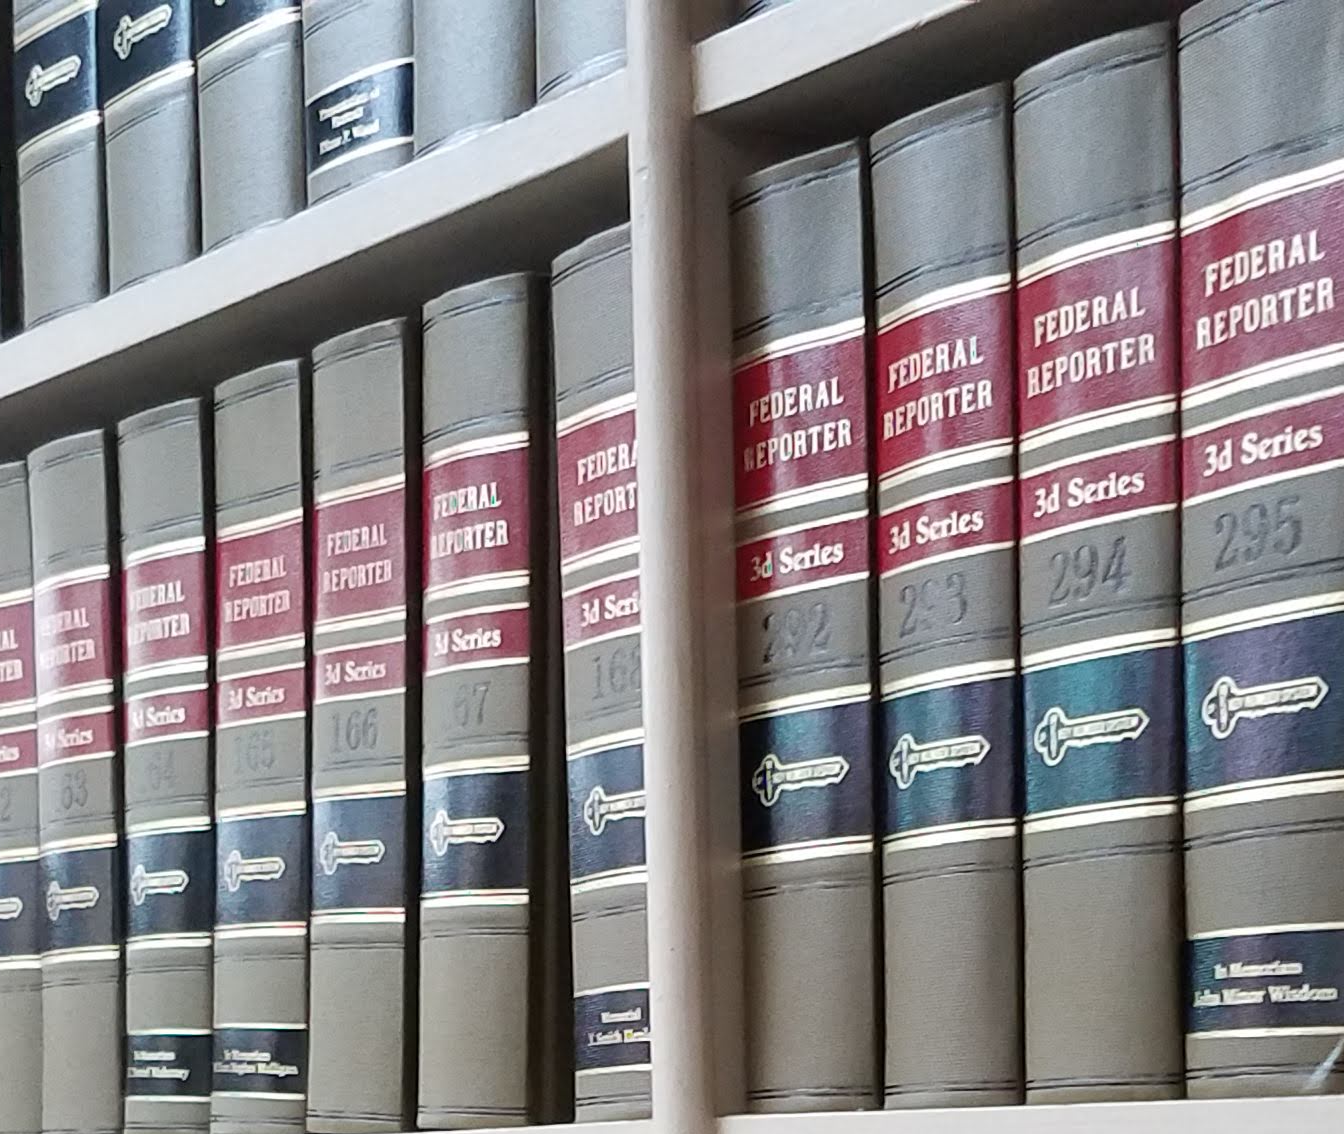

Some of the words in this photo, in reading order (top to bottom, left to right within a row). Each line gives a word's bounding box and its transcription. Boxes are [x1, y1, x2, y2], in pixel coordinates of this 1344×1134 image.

[1203, 228, 1326, 297] FEDERAL
[1033, 286, 1145, 348] FEDERAL
[1196, 277, 1335, 350] REPORTER
[887, 336, 984, 393] FEDERAL
[1026, 333, 1156, 399] REPORTER
[750, 375, 844, 427] FEDERAL
[882, 380, 994, 441] REPORTER
[577, 440, 637, 485] FEDERA
[744, 417, 852, 472] REPORTER
[1203, 440, 1234, 477] 3d
[1240, 423, 1323, 464] Series
[432, 481, 502, 521] FEDERAL
[573, 483, 637, 526] REPORT
[1033, 482, 1059, 518] 3d
[1067, 470, 1145, 508] Series
[326, 523, 387, 557] FEDERAL
[888, 524, 911, 556] 3d
[916, 507, 984, 545] Series
[1213, 497, 1301, 572] 295
[228, 556, 286, 587] FEDERAL
[322, 559, 392, 594] REPORTER
[750, 547, 772, 580] 3d
[779, 539, 844, 574] Series
[1048, 536, 1128, 608] 294
[581, 603, 599, 627] 3d
[606, 593, 640, 618] Seri
[452, 628, 502, 652] Series
[246, 686, 285, 707] Series
[324, 664, 340, 686] 3d
[343, 660, 387, 681] Series
[331, 707, 378, 753] 166
